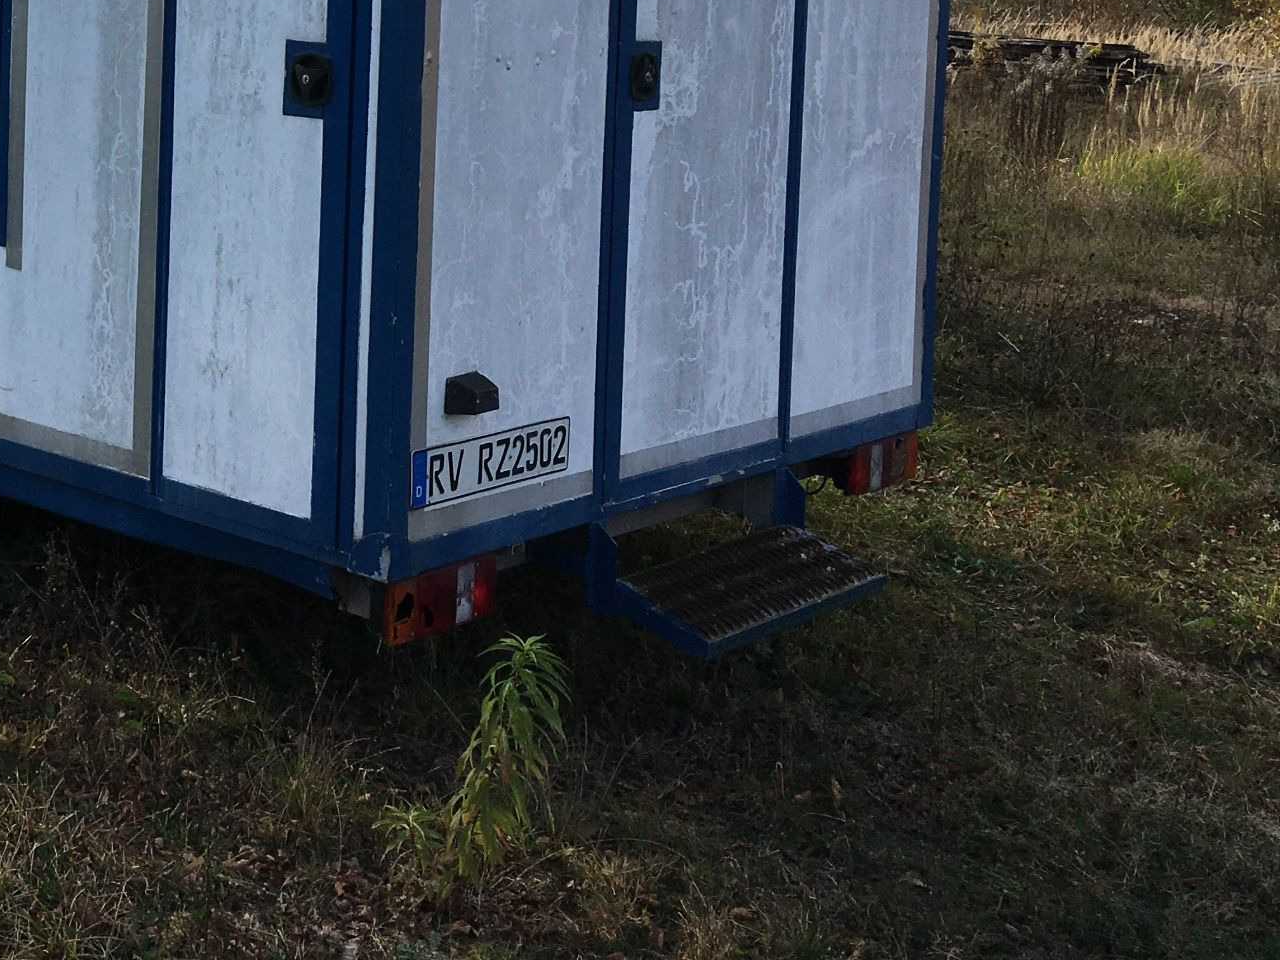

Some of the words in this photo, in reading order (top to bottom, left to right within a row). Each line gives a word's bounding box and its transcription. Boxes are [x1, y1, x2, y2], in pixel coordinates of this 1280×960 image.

[415, 485, 423, 498] D
[428, 448, 464, 497] RV
[477, 425, 567, 485] RZ2502
